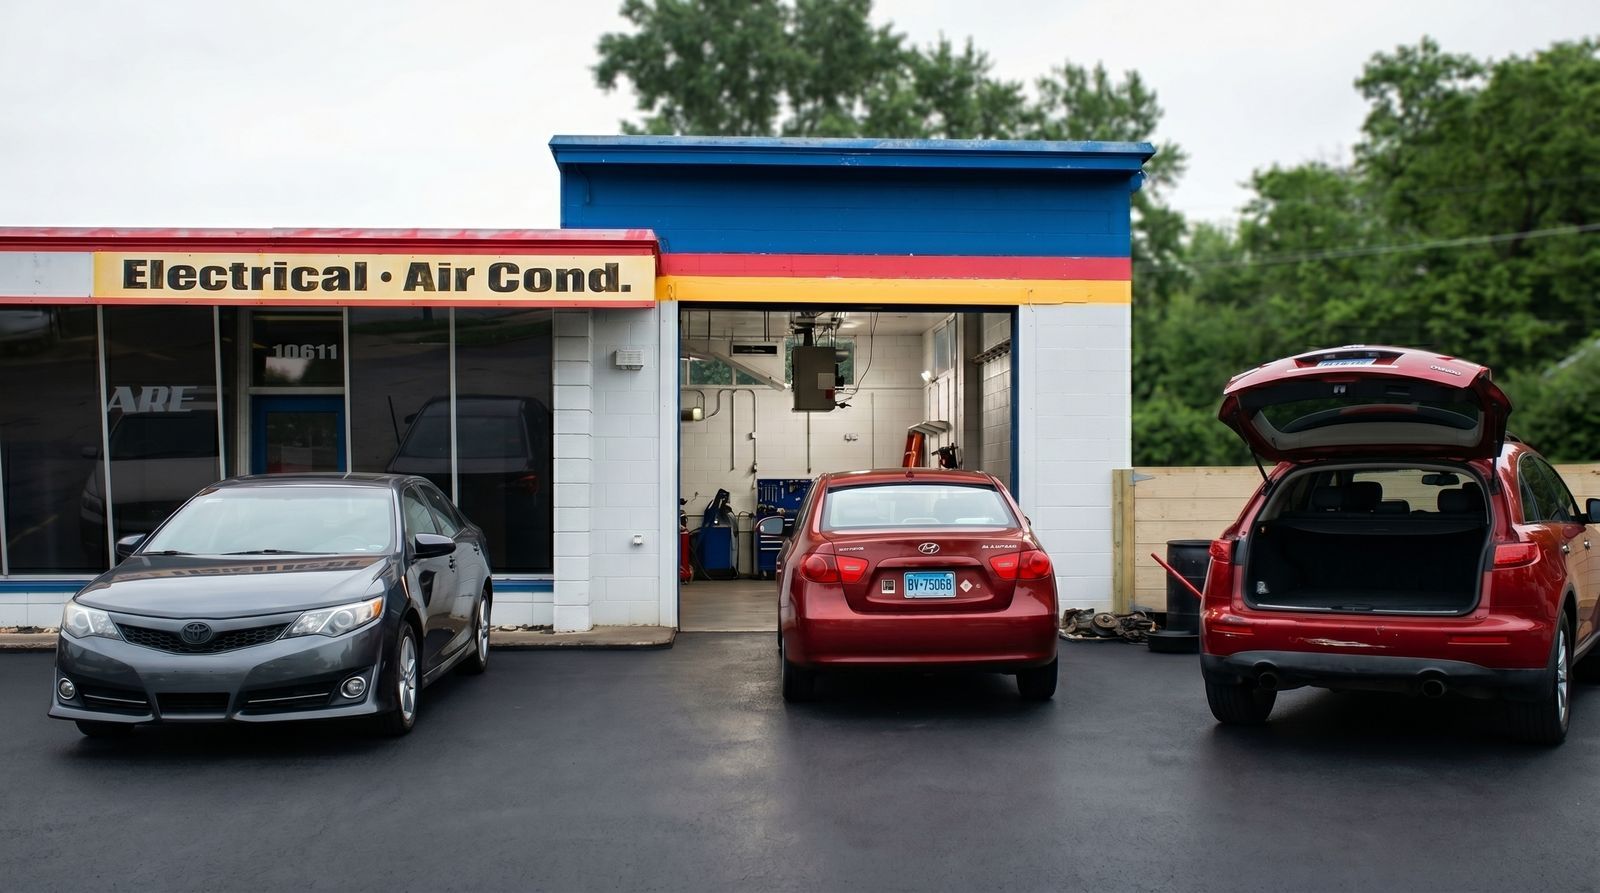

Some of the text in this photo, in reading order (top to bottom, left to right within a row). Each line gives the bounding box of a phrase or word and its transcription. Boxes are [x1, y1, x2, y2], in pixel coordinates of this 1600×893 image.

[122, 259, 632, 293] Electrical Air Cond.
[272, 343, 337, 360] 10611
[107, 385, 198, 413] ARE
